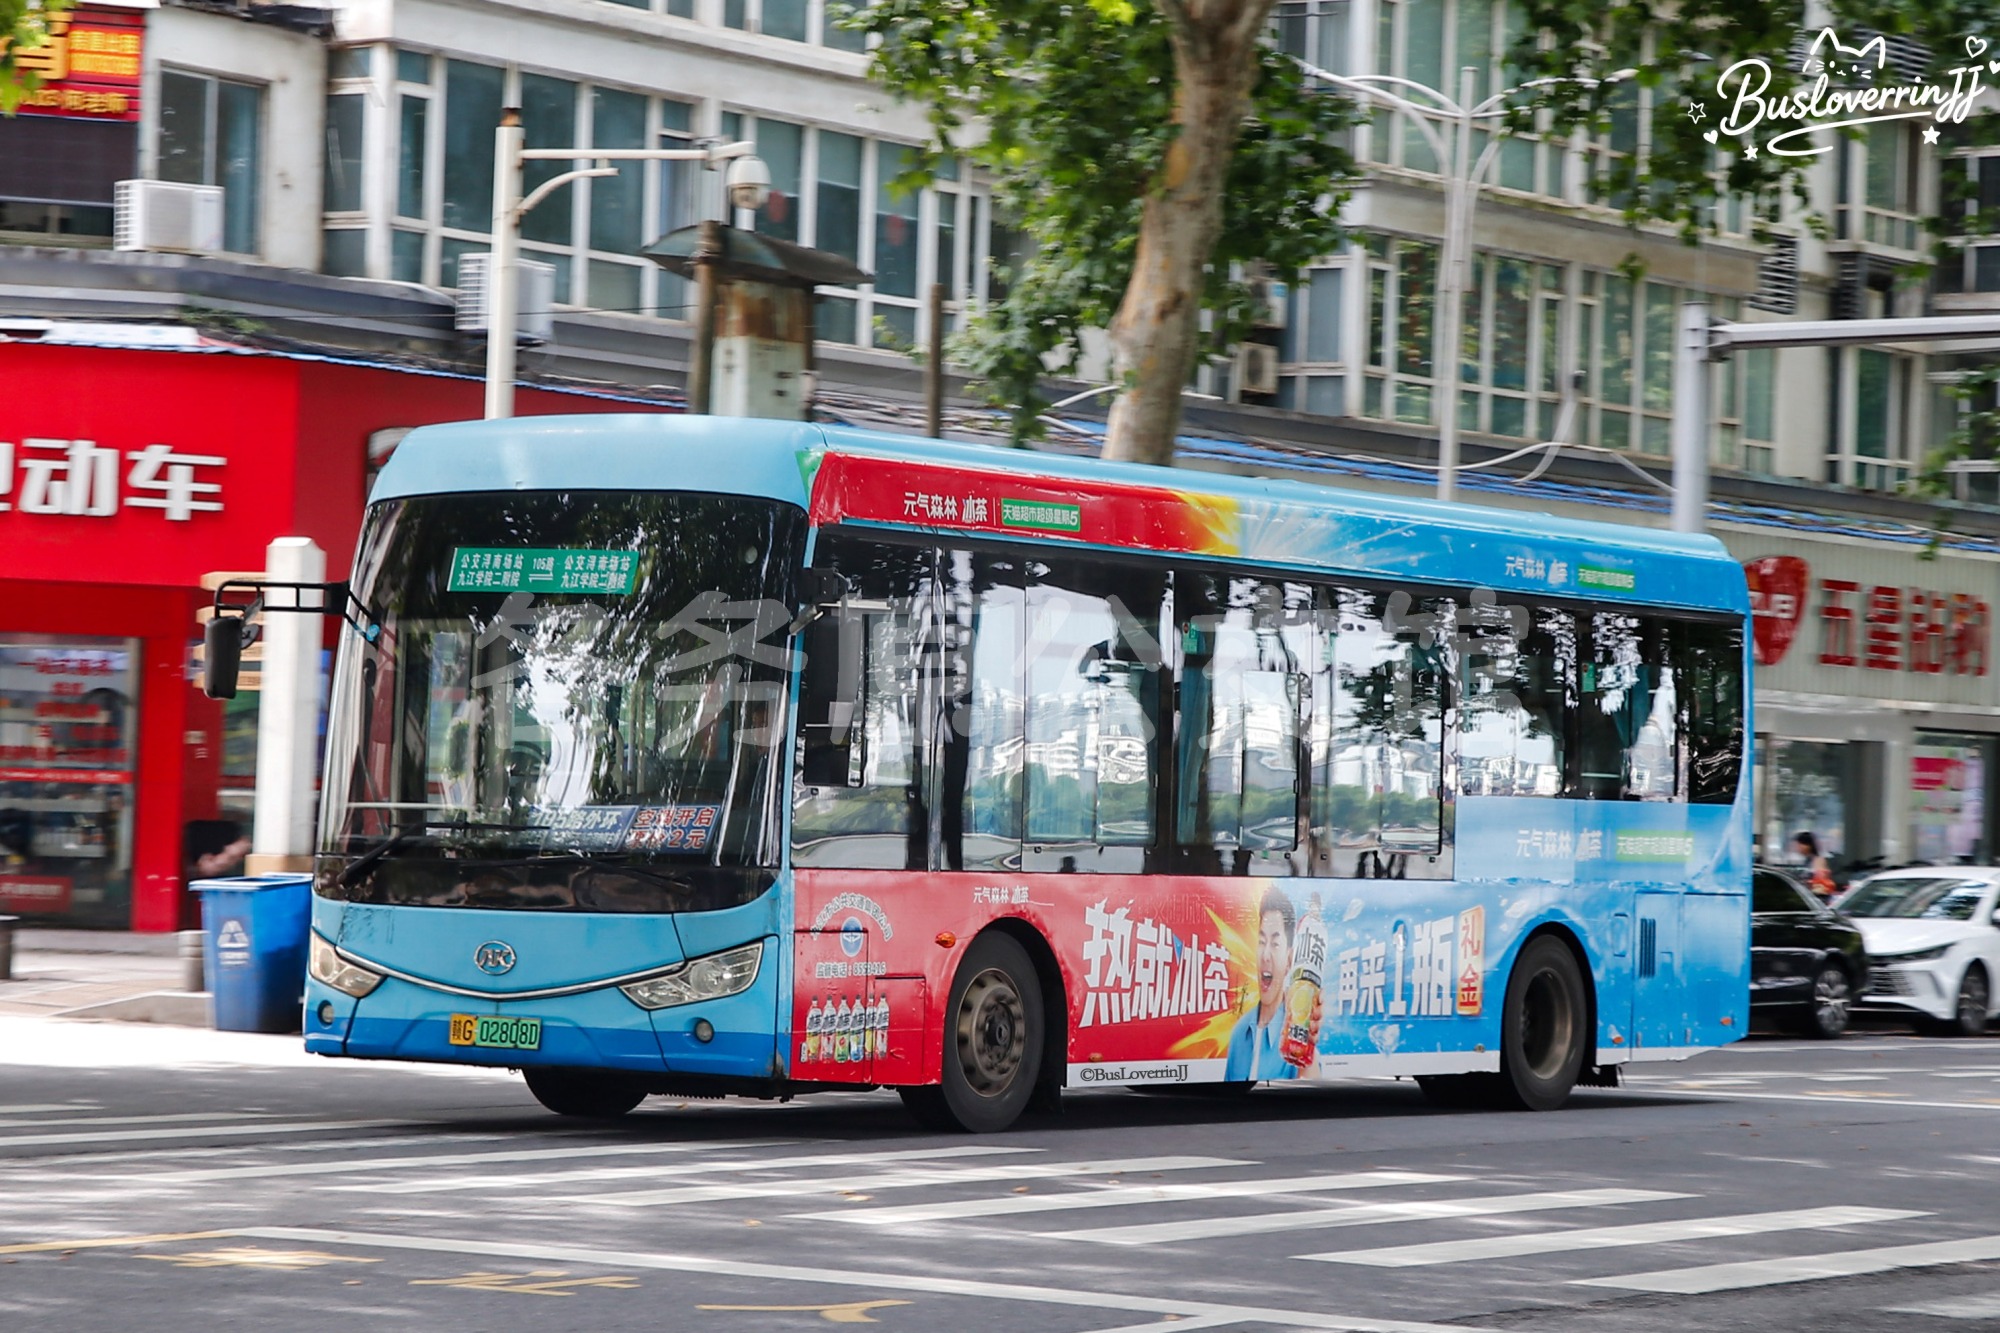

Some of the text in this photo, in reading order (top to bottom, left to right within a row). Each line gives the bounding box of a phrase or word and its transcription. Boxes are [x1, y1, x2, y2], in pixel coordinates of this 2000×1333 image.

[904, 491, 988, 524] 元气森林 冰茶
[1505, 555, 1546, 581] 元气森林
[1515, 828, 1572, 859] 元气森林
[973, 886, 1009, 904] 元气森林
[1079, 897, 1230, 1029] 热就冰茶
[1339, 916, 1455, 1017] 再来1瓶
[1460, 914, 1481, 1007] 礼金
